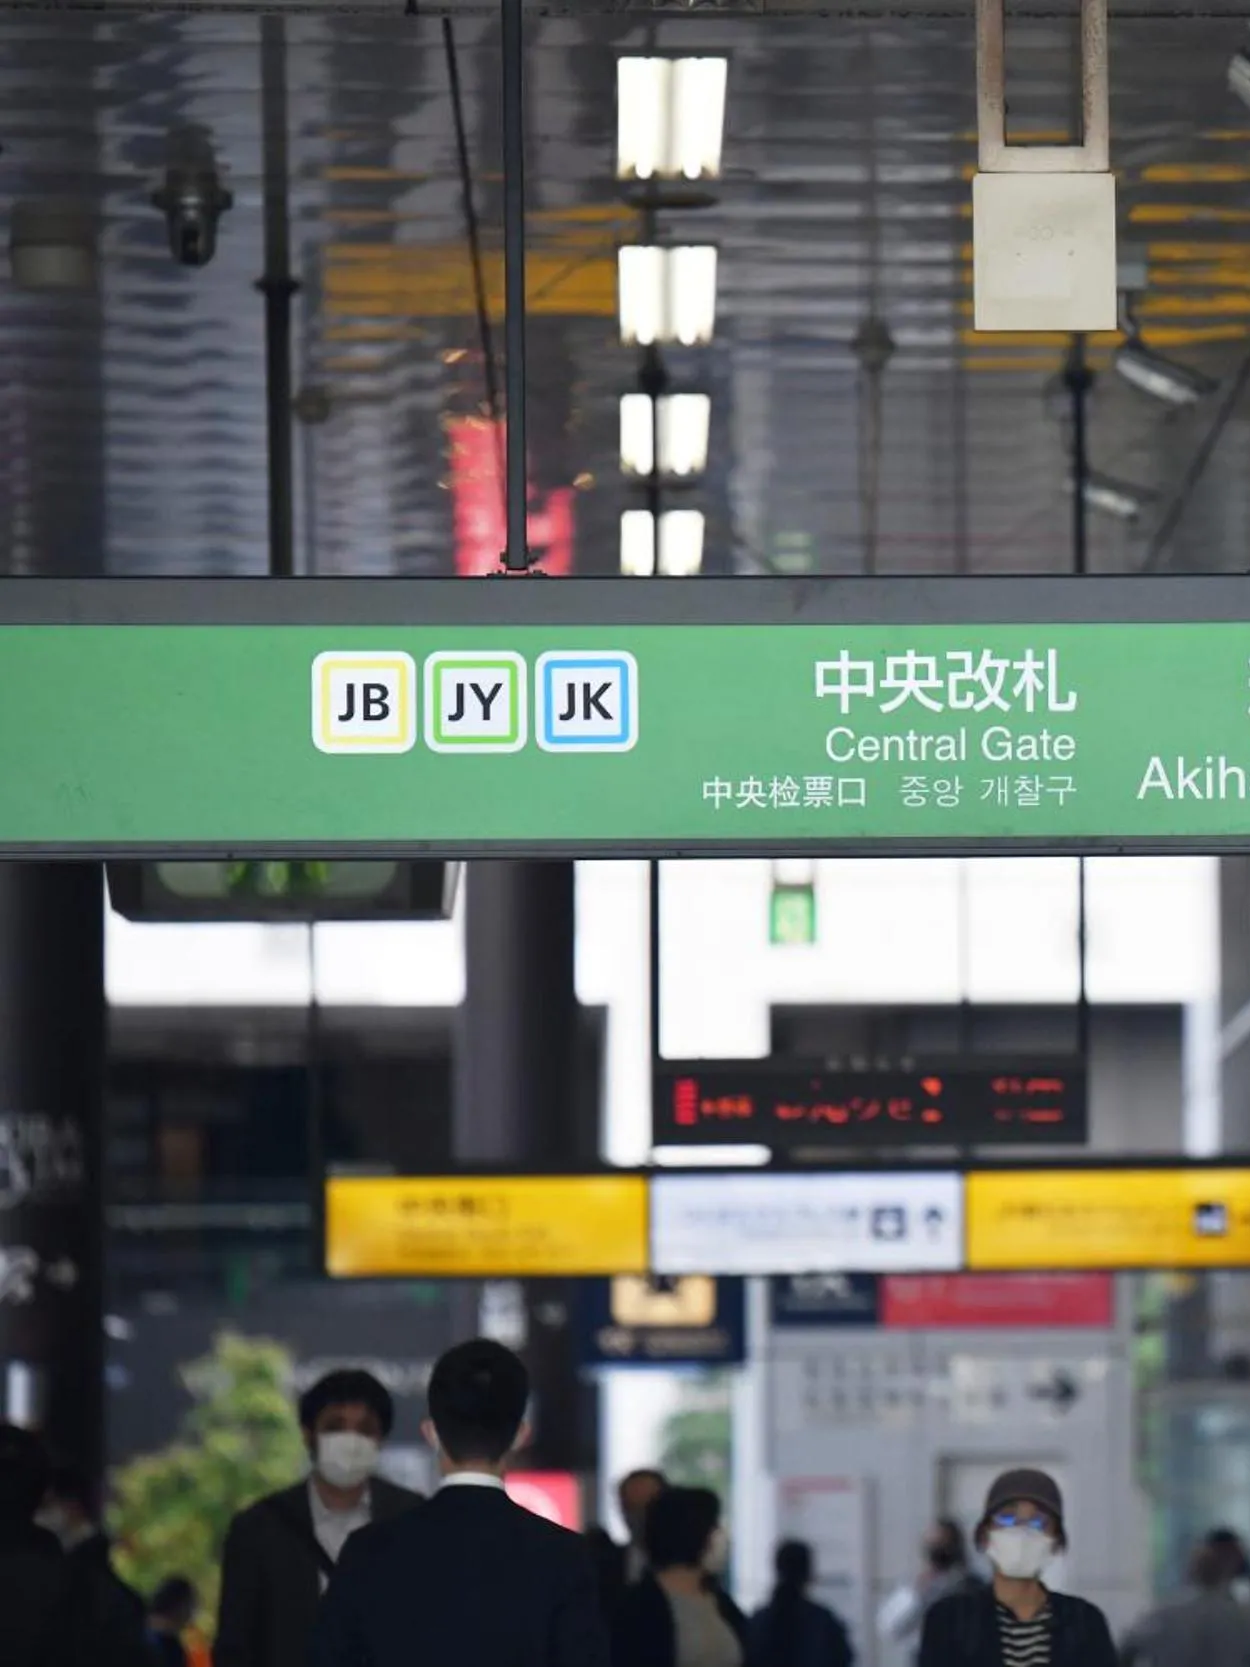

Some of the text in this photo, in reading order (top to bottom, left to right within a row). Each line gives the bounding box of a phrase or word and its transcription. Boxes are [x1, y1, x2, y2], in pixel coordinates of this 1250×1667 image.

[815, 648, 1078, 714] 中央改札
[338, 682, 613, 722] JB JY JK
[825, 725, 1077, 762] Central Gate
[702, 775, 868, 809] 中央检票口
[899, 775, 1078, 808] 중앙 개찰구
